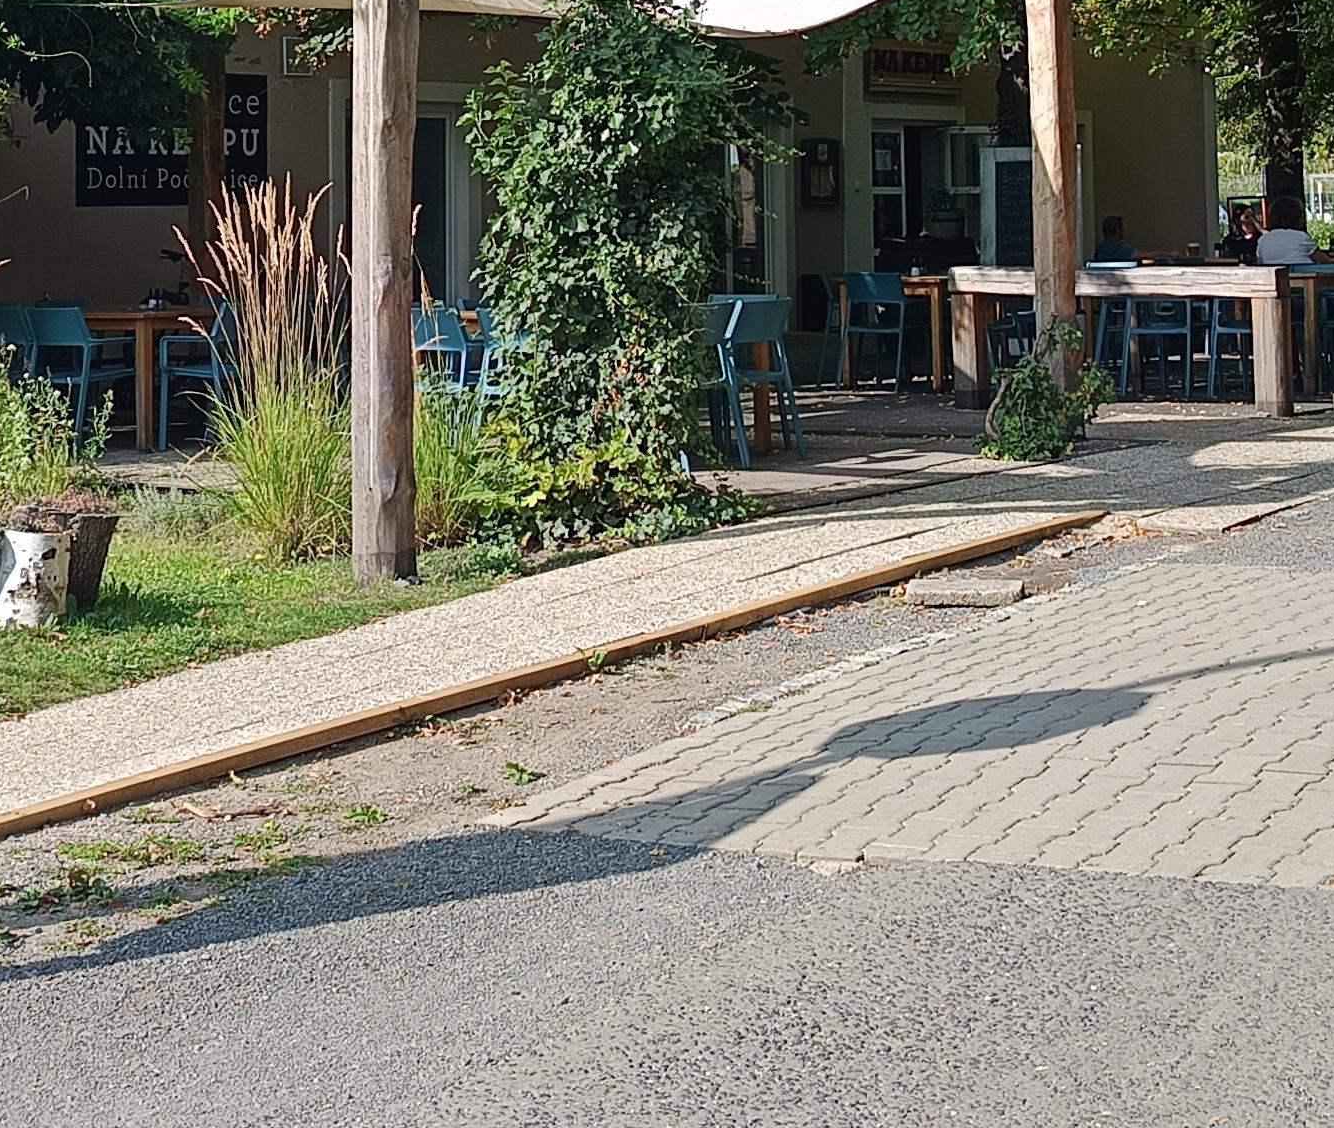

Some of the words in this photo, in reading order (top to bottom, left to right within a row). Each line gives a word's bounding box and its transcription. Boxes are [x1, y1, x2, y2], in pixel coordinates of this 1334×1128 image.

[85, 125, 135, 156] NA
[148, 127, 260, 157] KEPU
[87, 165, 148, 190] Dolní
